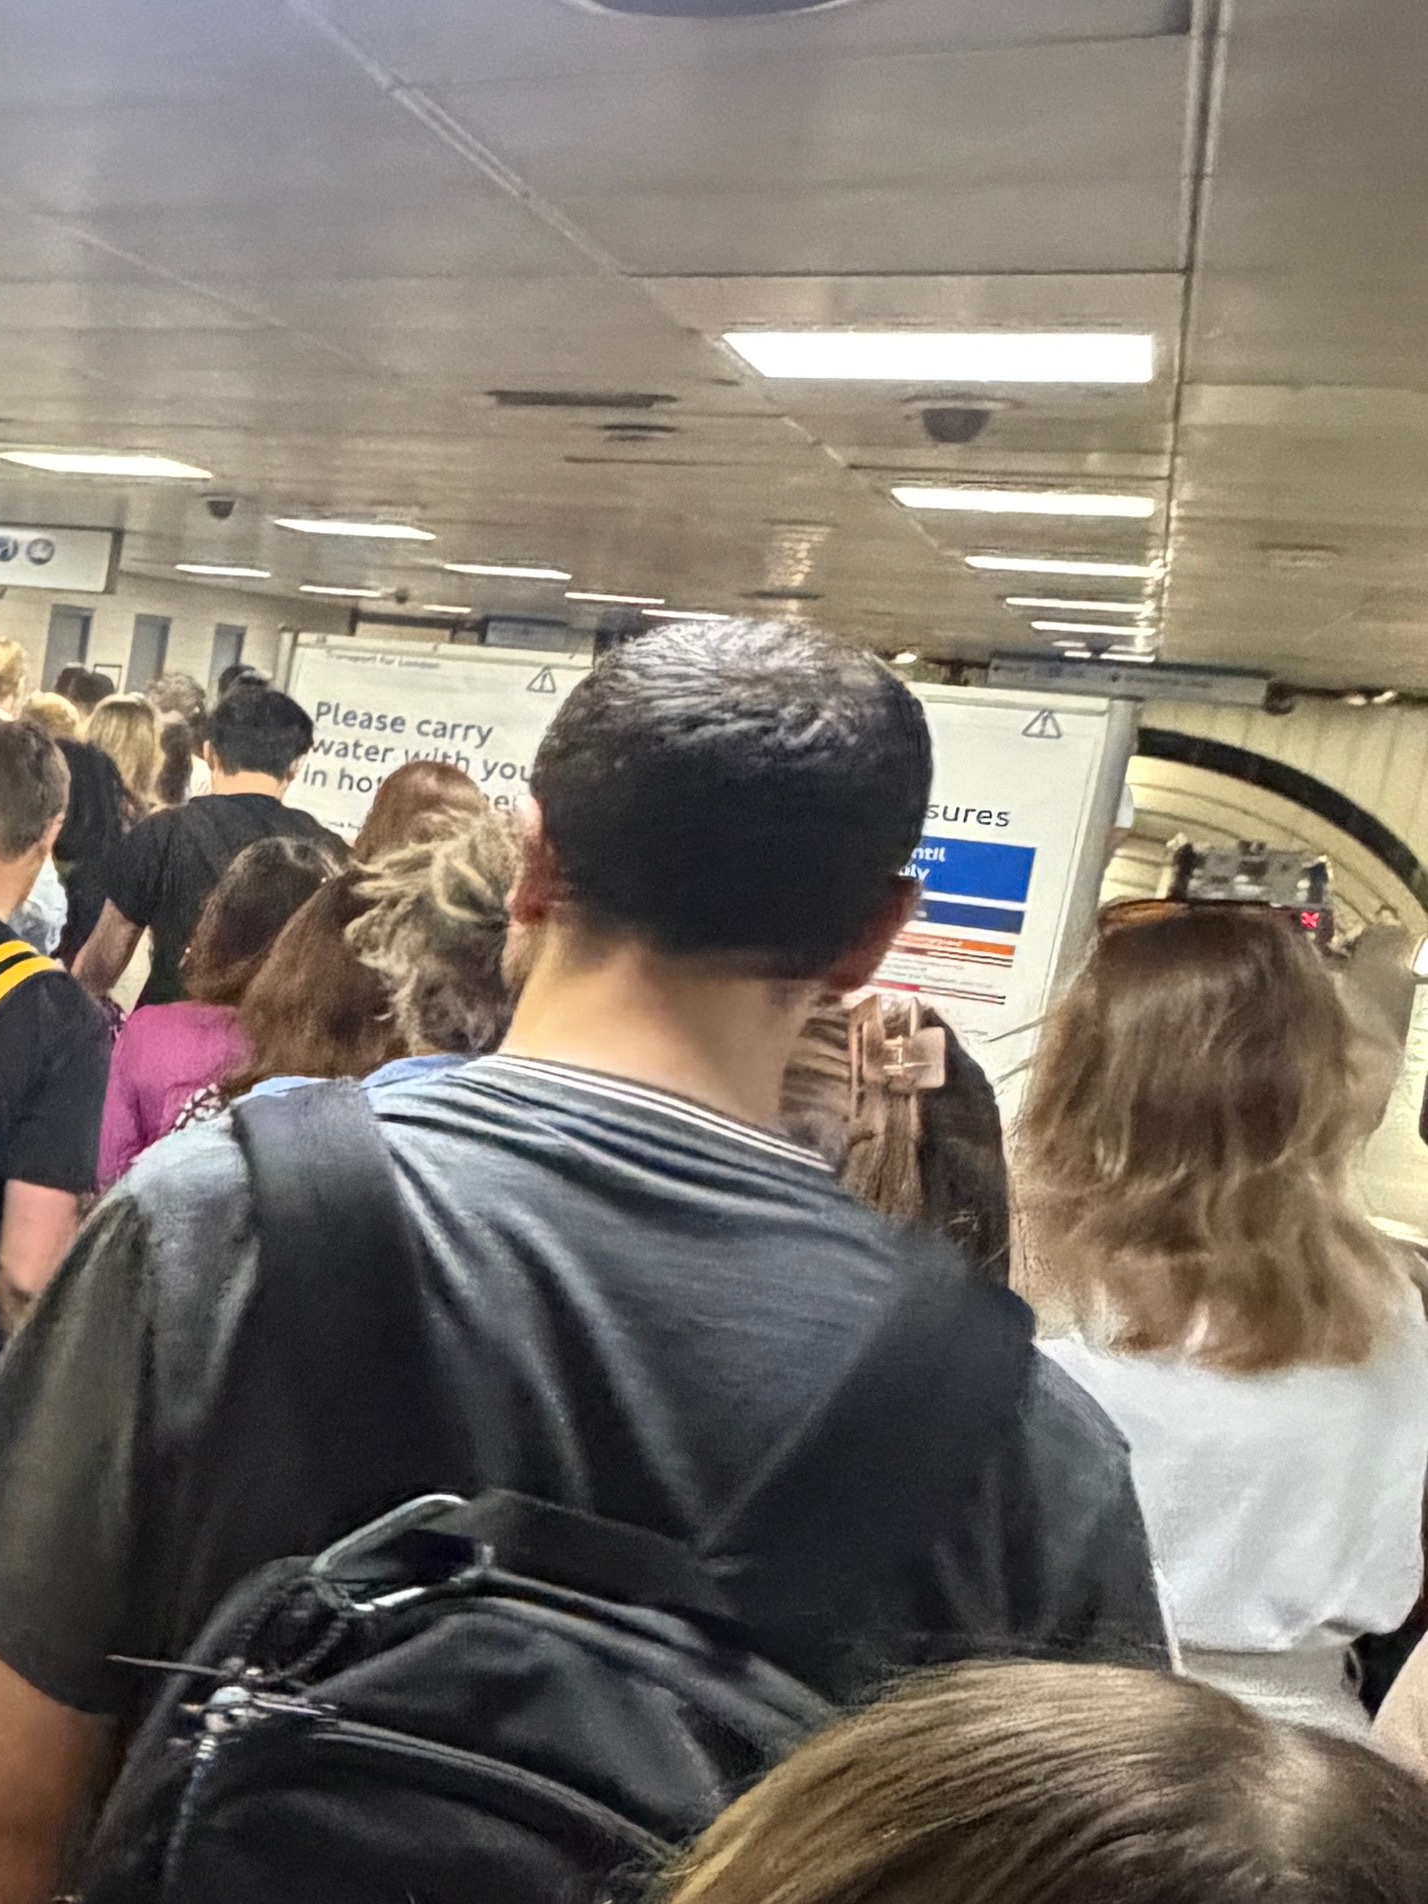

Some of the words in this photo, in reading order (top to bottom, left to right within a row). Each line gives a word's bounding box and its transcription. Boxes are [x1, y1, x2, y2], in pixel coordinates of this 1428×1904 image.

[315, 700, 408, 735] Please
[416, 718, 494, 749] carry
[312, 737, 395, 764] water
[926, 803, 1011, 828] sures
[911, 847, 946, 863] ntil
